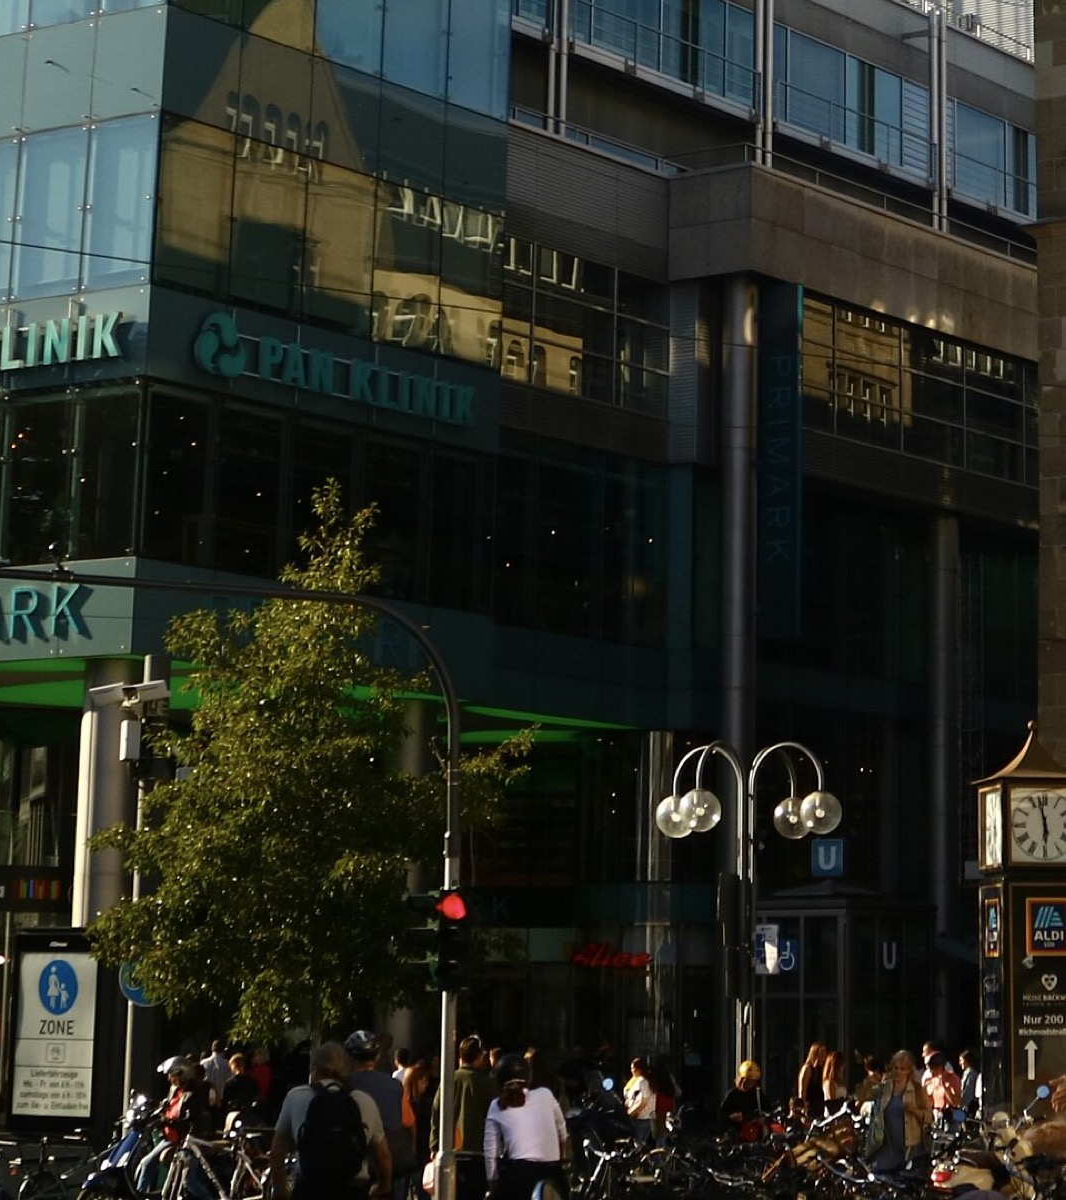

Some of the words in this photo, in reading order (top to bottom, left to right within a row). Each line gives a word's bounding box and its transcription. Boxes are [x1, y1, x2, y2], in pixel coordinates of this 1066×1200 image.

[258, 335, 334, 396] PAN
[349, 357, 475, 427] KLINIK
[766, 354, 792, 563] PRIMARK
[818, 845, 837, 870] U
[1034, 929, 1065, 941] ALDI
[883, 942, 898, 971] U
[39, 1019, 75, 1036] ZONE
[1023, 1014, 1043, 1025] Nur
[1044, 1014, 1064, 1025] 200
